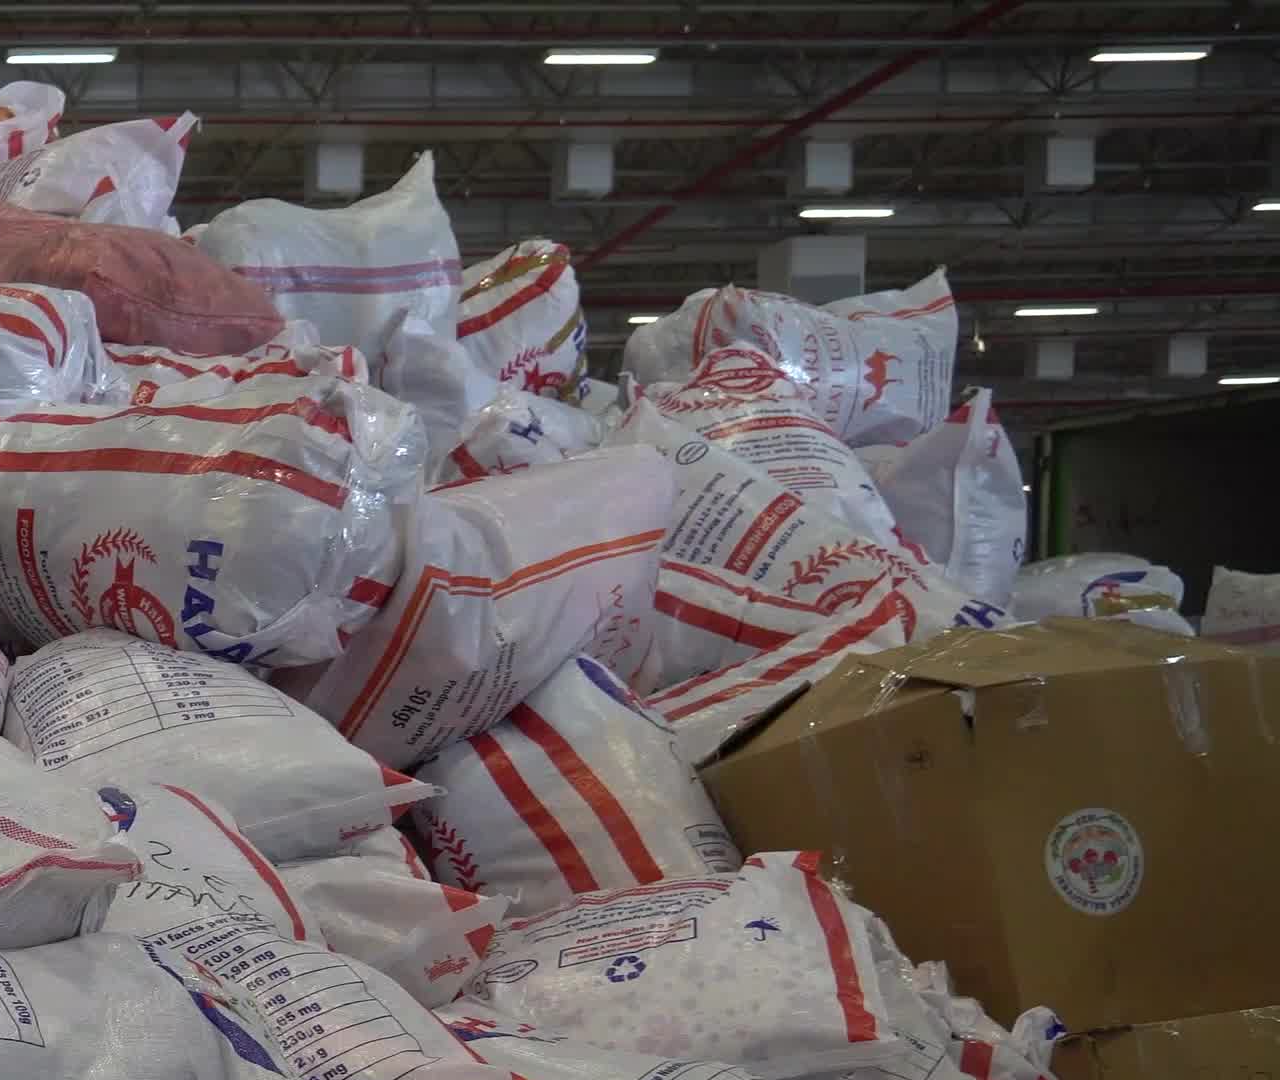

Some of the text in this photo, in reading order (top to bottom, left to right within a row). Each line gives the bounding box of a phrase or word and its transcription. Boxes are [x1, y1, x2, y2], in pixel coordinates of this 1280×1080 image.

[42, 753, 69, 769] Iron
[167, 923, 204, 945] facts
[186, 926, 240, 955] Content
[203, 950, 230, 968] 100
[253, 949, 276, 967] mg
[268, 965, 292, 982] mg
[298, 1001, 322, 1018] mg
[323, 1063, 349, 1080] mg
